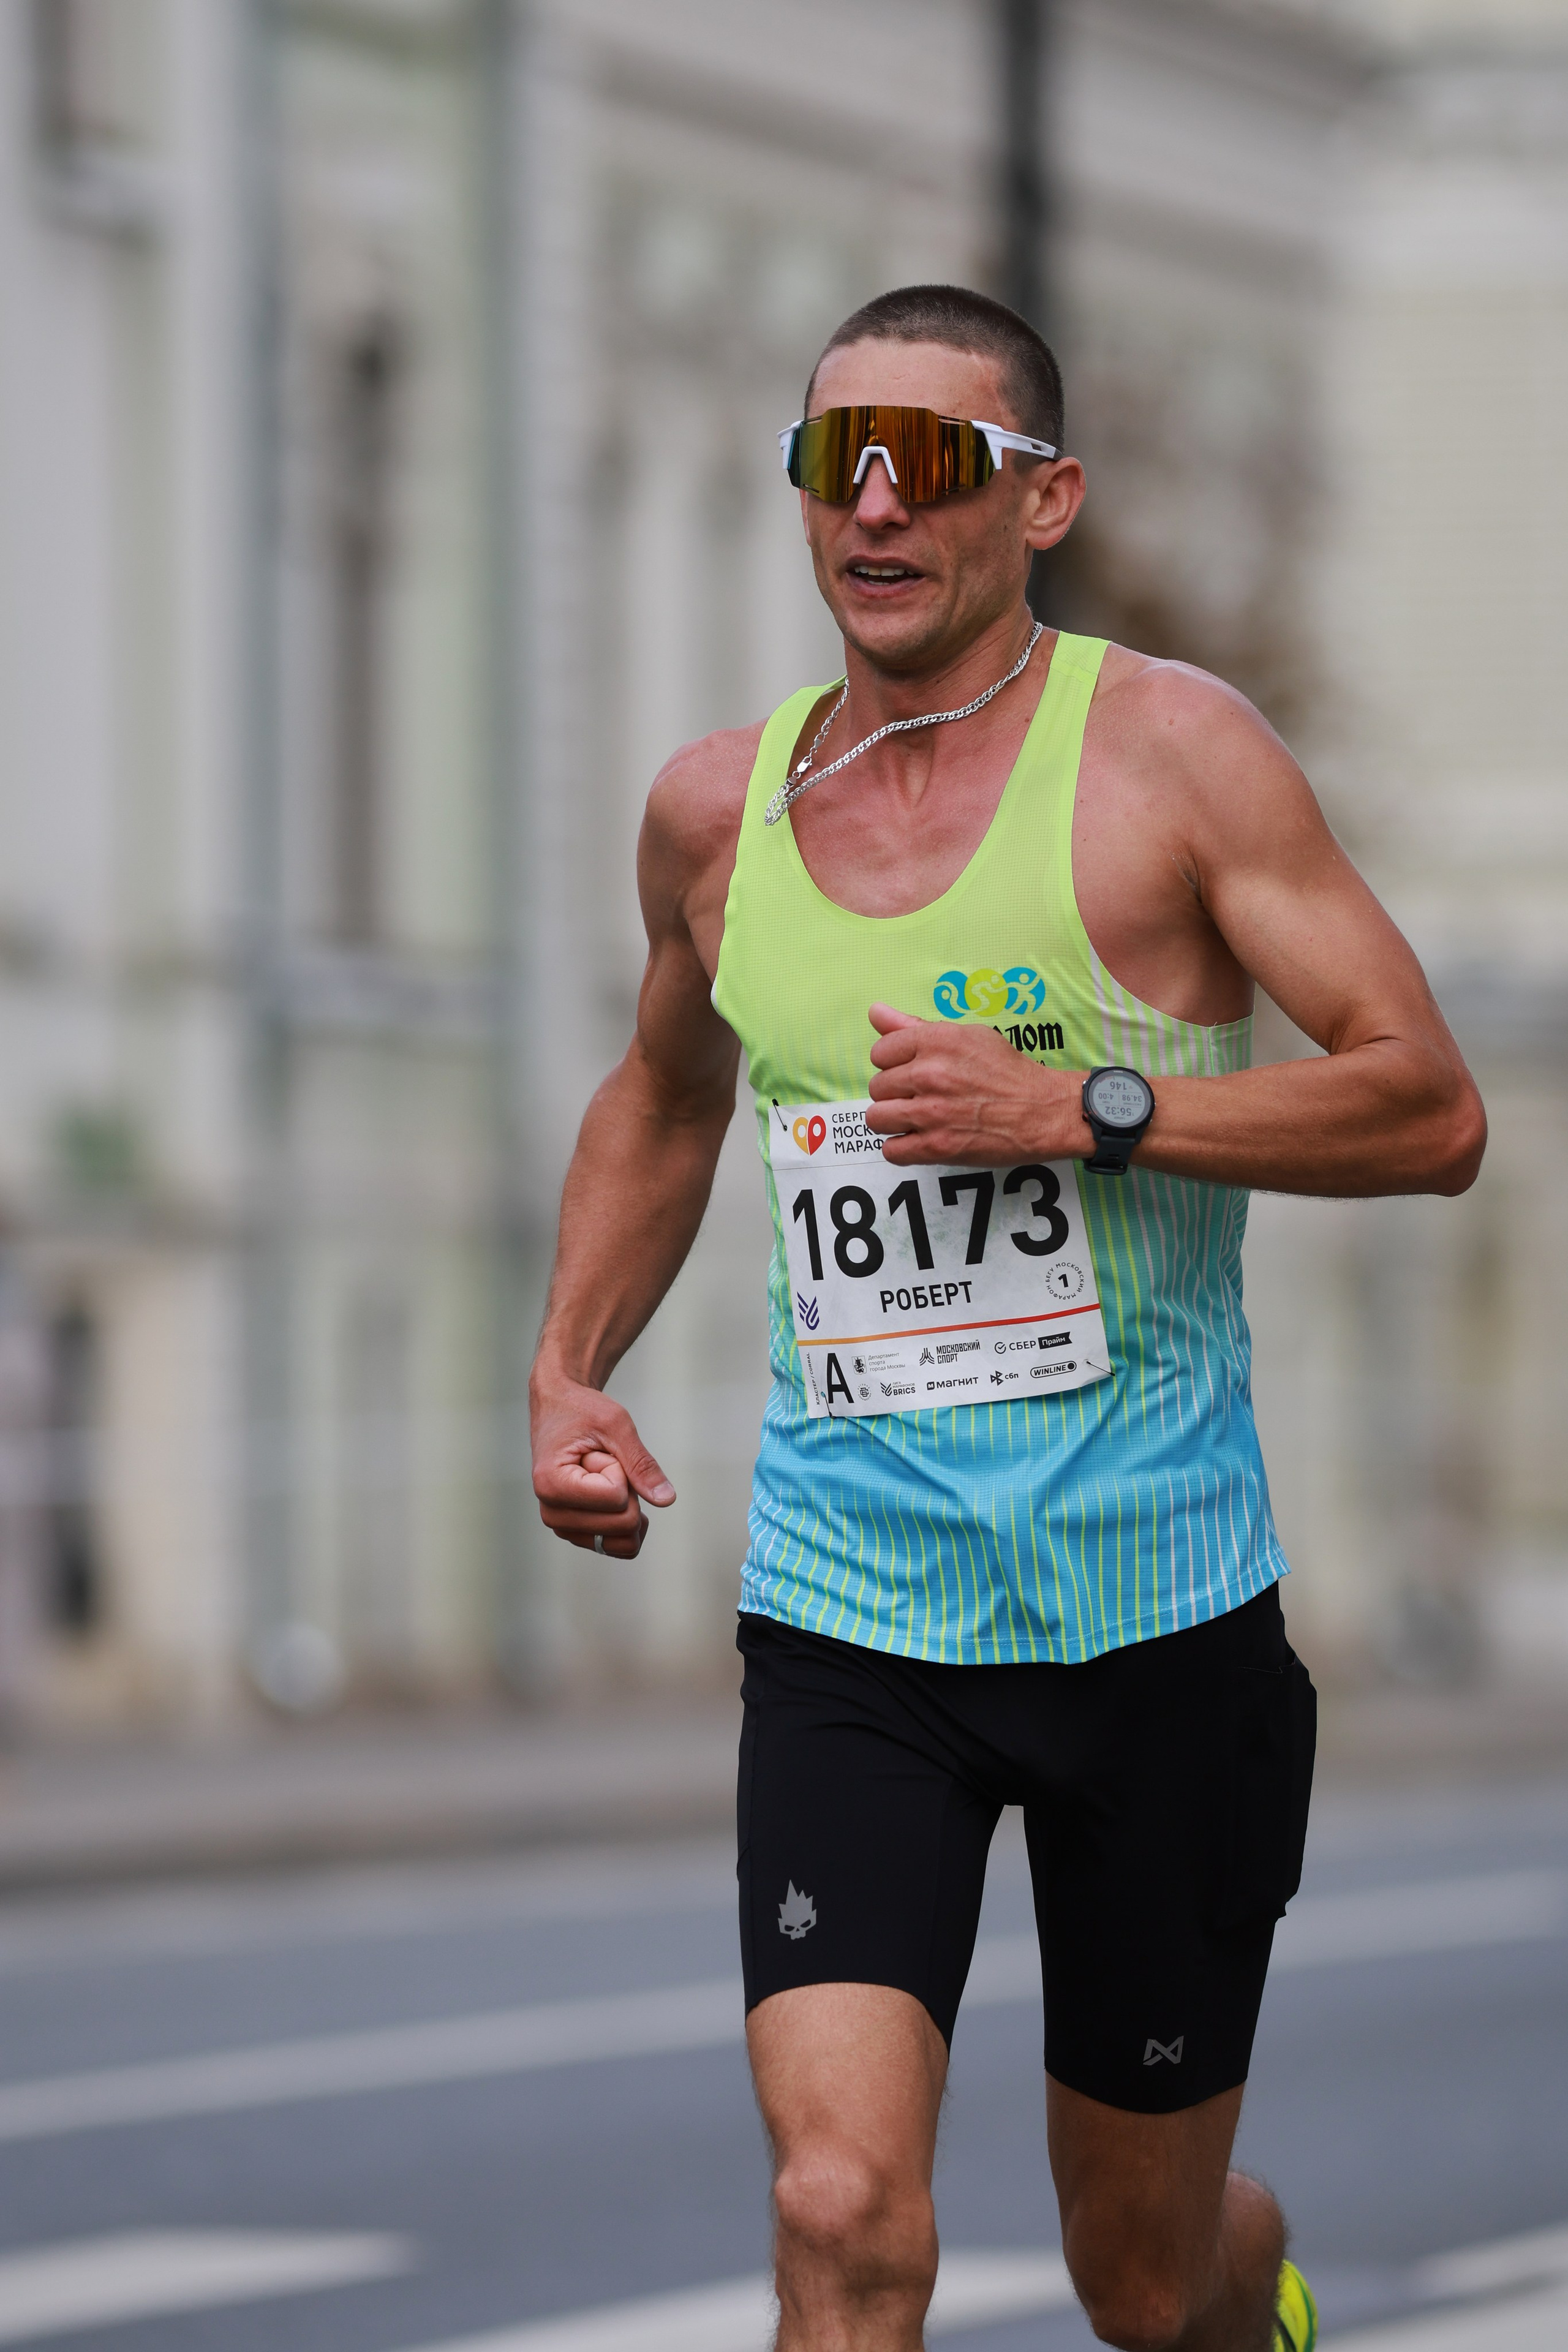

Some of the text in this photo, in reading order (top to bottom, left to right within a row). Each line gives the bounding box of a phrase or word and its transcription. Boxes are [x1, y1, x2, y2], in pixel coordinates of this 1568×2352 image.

[1110, 1081, 1127, 1090] 146
[832, 1111, 866, 1123] СБЕРП
[833, 1125, 873, 1139] МОСК
[835, 1138, 884, 1154] МАРАФ
[793, 1164, 1069, 1281] 18173
[1046, 1262, 1085, 1300] БЕГУ МОСКОВСКИЙ МАРАФОН
[1058, 1273, 1069, 1288] 1
[880, 1281, 973, 1313] РОБЕРТ
[936, 1339, 981, 1355] МОСКОВСКИЙ
[1009, 1336, 1066, 1351] СБЕР Прайм
[937, 1353, 958, 1364] СПОРТ
[1034, 1365, 1066, 1376] WINLINE
[812, 1379, 820, 1405] КЛАСТЕР
[893, 1387, 916, 1396] BRICS
